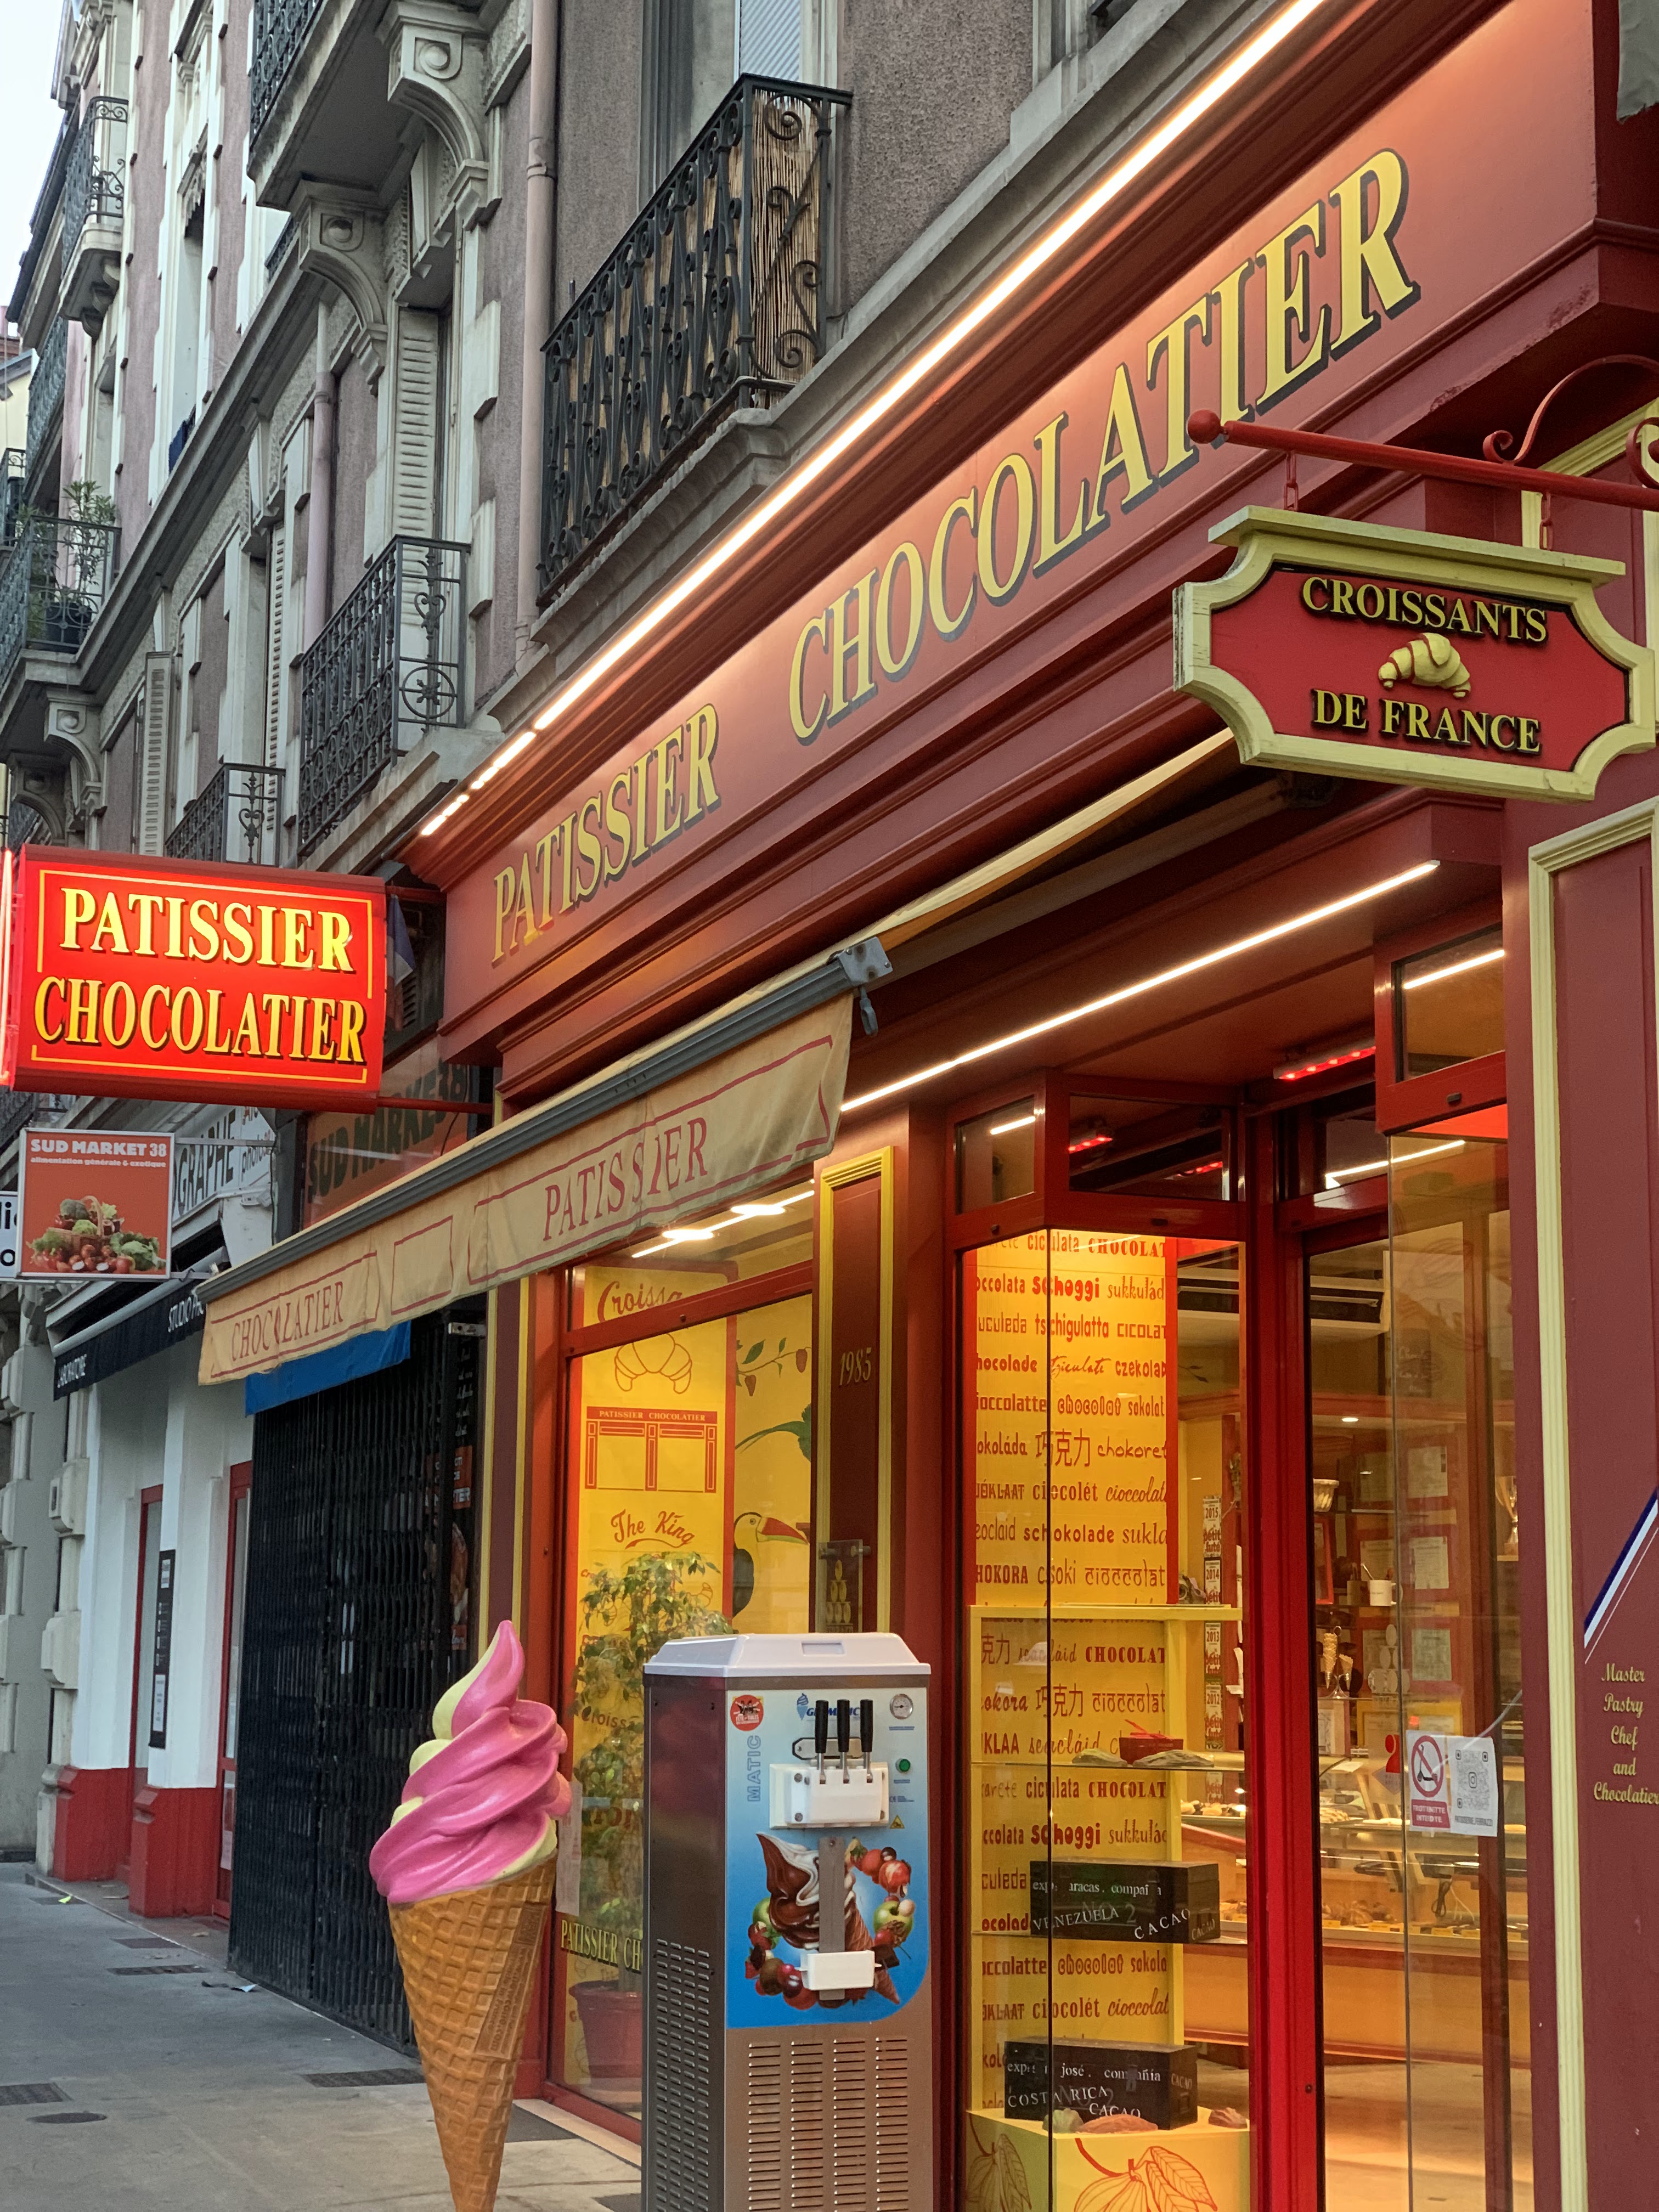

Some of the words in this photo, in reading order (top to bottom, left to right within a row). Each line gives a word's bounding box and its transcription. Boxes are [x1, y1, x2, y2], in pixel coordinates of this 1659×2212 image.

[492, 703, 721, 966] PATISSIER
[789, 149, 1420, 744] CHOCOLATIER
[1301, 575, 1548, 644] CROISSANTS
[1311, 689, 1367, 730] DE
[1379, 697, 1541, 754] FRANCE
[60, 887, 357, 974] PATISSIER
[34, 975, 366, 1064] CHOCOLATIER
[31, 1139, 69, 1153] SUD
[72, 1141, 147, 1156] MARKET
[149, 1143, 167, 1157] 38
[172, 1108, 236, 1216] GRAPHE
[308, 1126, 348, 1203] SUD
[231, 1281, 343, 1362] CHOCOLATIER
[543, 1116, 708, 1242] PATISSIER
[839, 1347, 873, 1386] 1985
[600, 1410, 643, 1418] PATISSIER
[648, 1412, 706, 1421] CHOCOLATIER
[1205, 1508, 1218, 1519] 2015
[611, 1509, 646, 1543] The
[655, 1510, 696, 1546] King
[1206, 1569, 1219, 1579] 2014
[1206, 1631, 1219, 1642] 2013
[1086, 1646, 1165, 1663] CHOCOLAT
[1601, 1663, 1645, 1682] Master
[982, 1685, 1029, 1712] okora
[1207, 1693, 1220, 1705] 2012
[1603, 1692, 1644, 1719] Pastry
[981, 1731, 1020, 1754] KLAA
[1611, 1725, 1638, 1751] Chef
[747, 1735, 761, 1802] MATIC
[1613, 1757, 1637, 1775] and
[1088, 1781, 1166, 1798] CHOCOLAT
[1033, 1906, 1119, 1931] VENEZUELA
[1134, 1908, 1190, 1940] CACAO
[561, 1919, 618, 1965] PATISSIER
[624, 1937, 644, 1971] CH
[1008, 2091, 1062, 2108] COSTA
[1070, 2086, 1108, 2102] RICA
